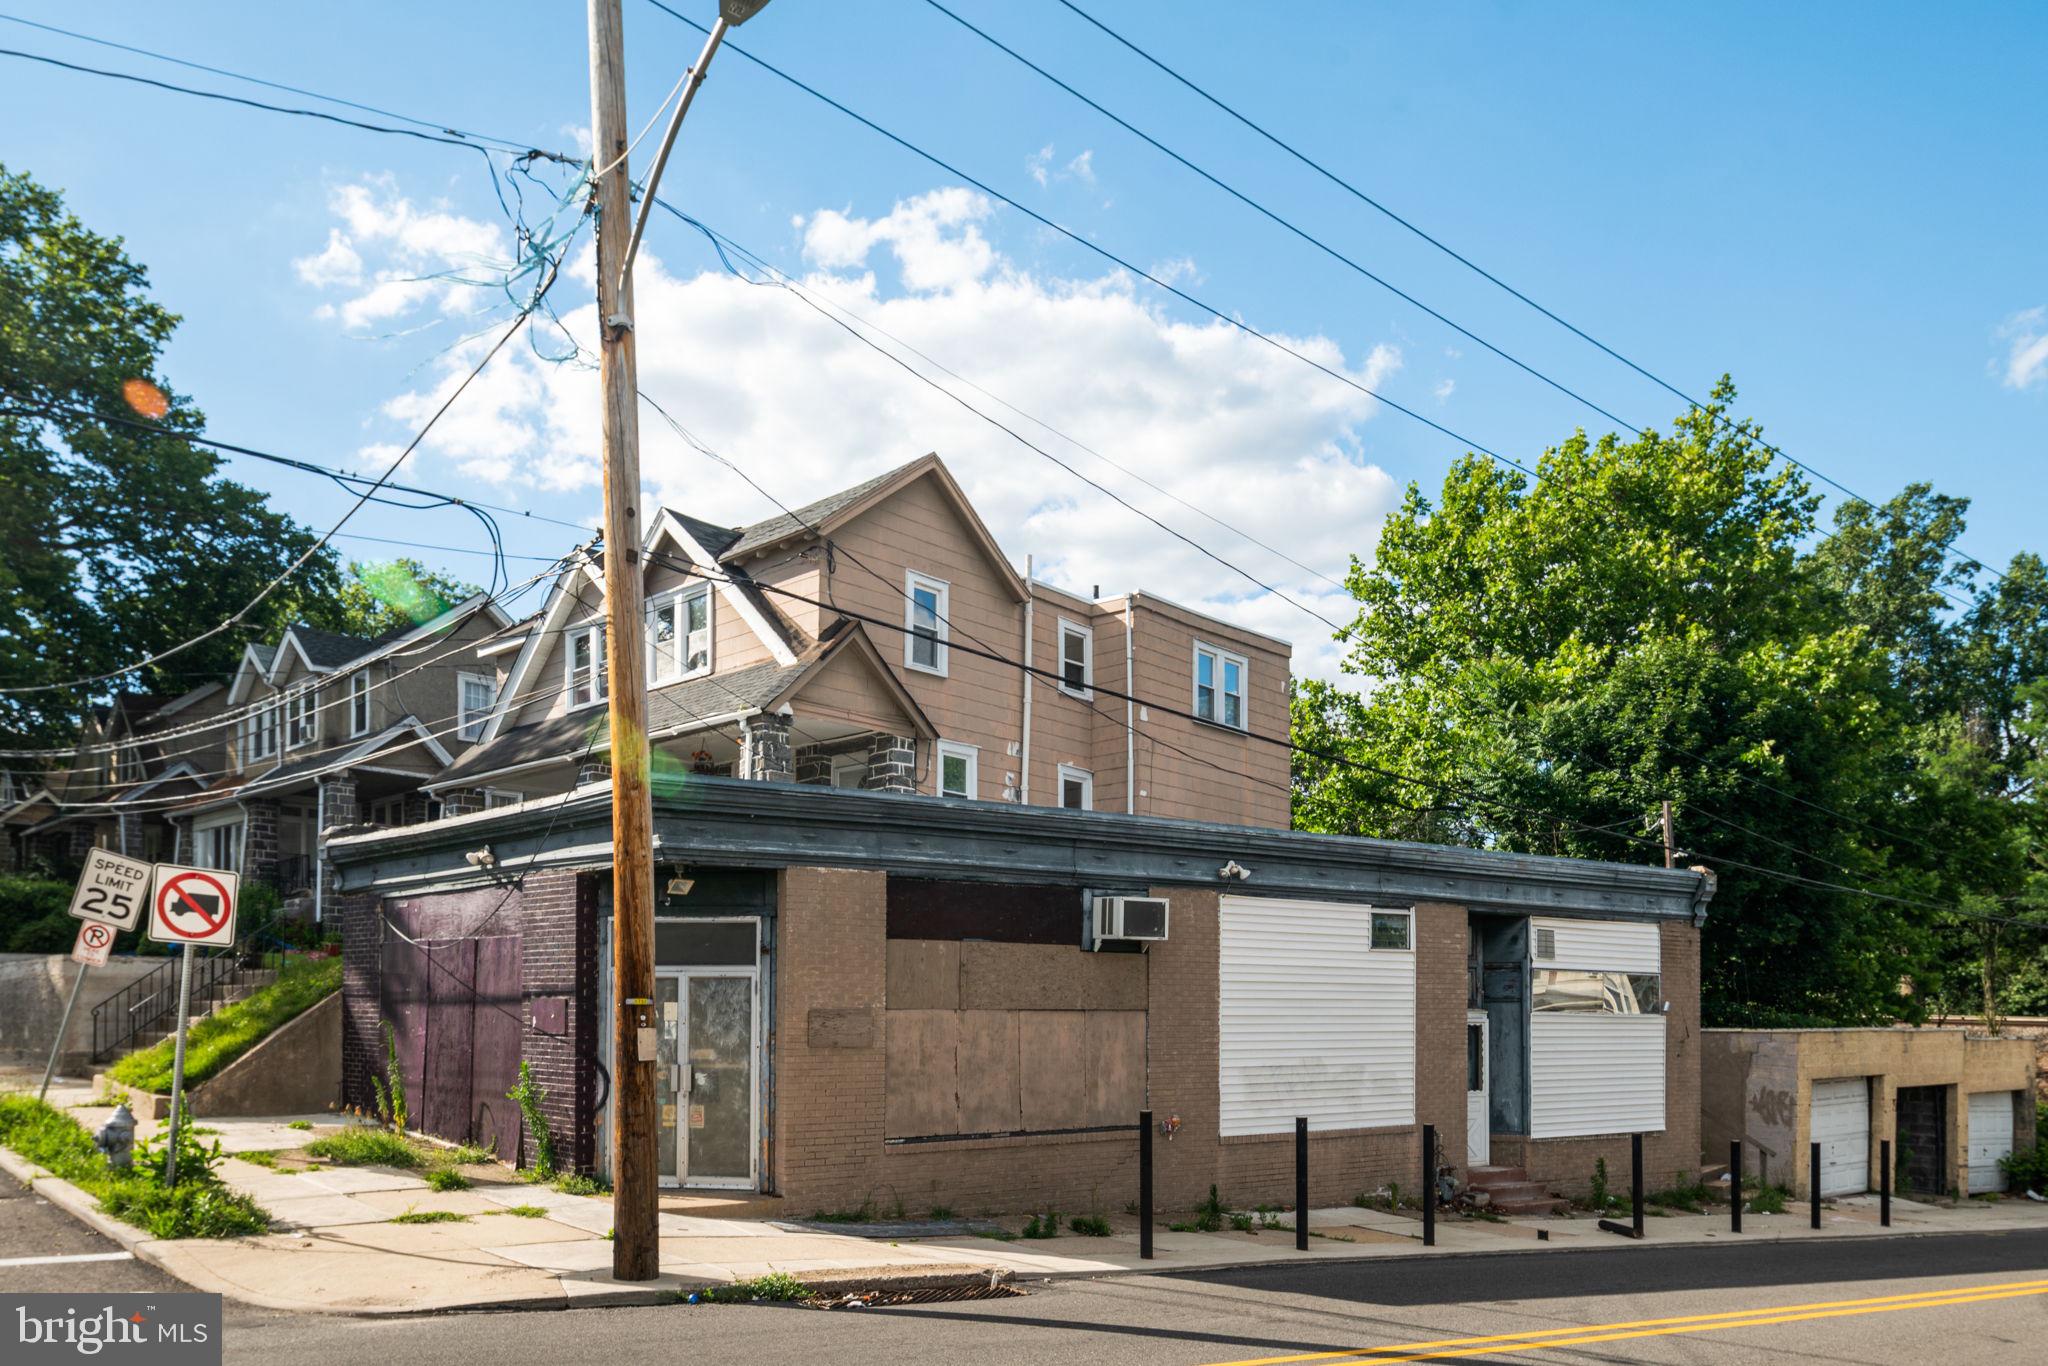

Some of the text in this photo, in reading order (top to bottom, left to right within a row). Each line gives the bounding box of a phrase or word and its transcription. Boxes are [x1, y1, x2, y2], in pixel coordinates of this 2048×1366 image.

[94, 858, 144, 880] SPEED
[95, 873, 134, 892] LIMIT
[81, 887, 133, 919] 25
